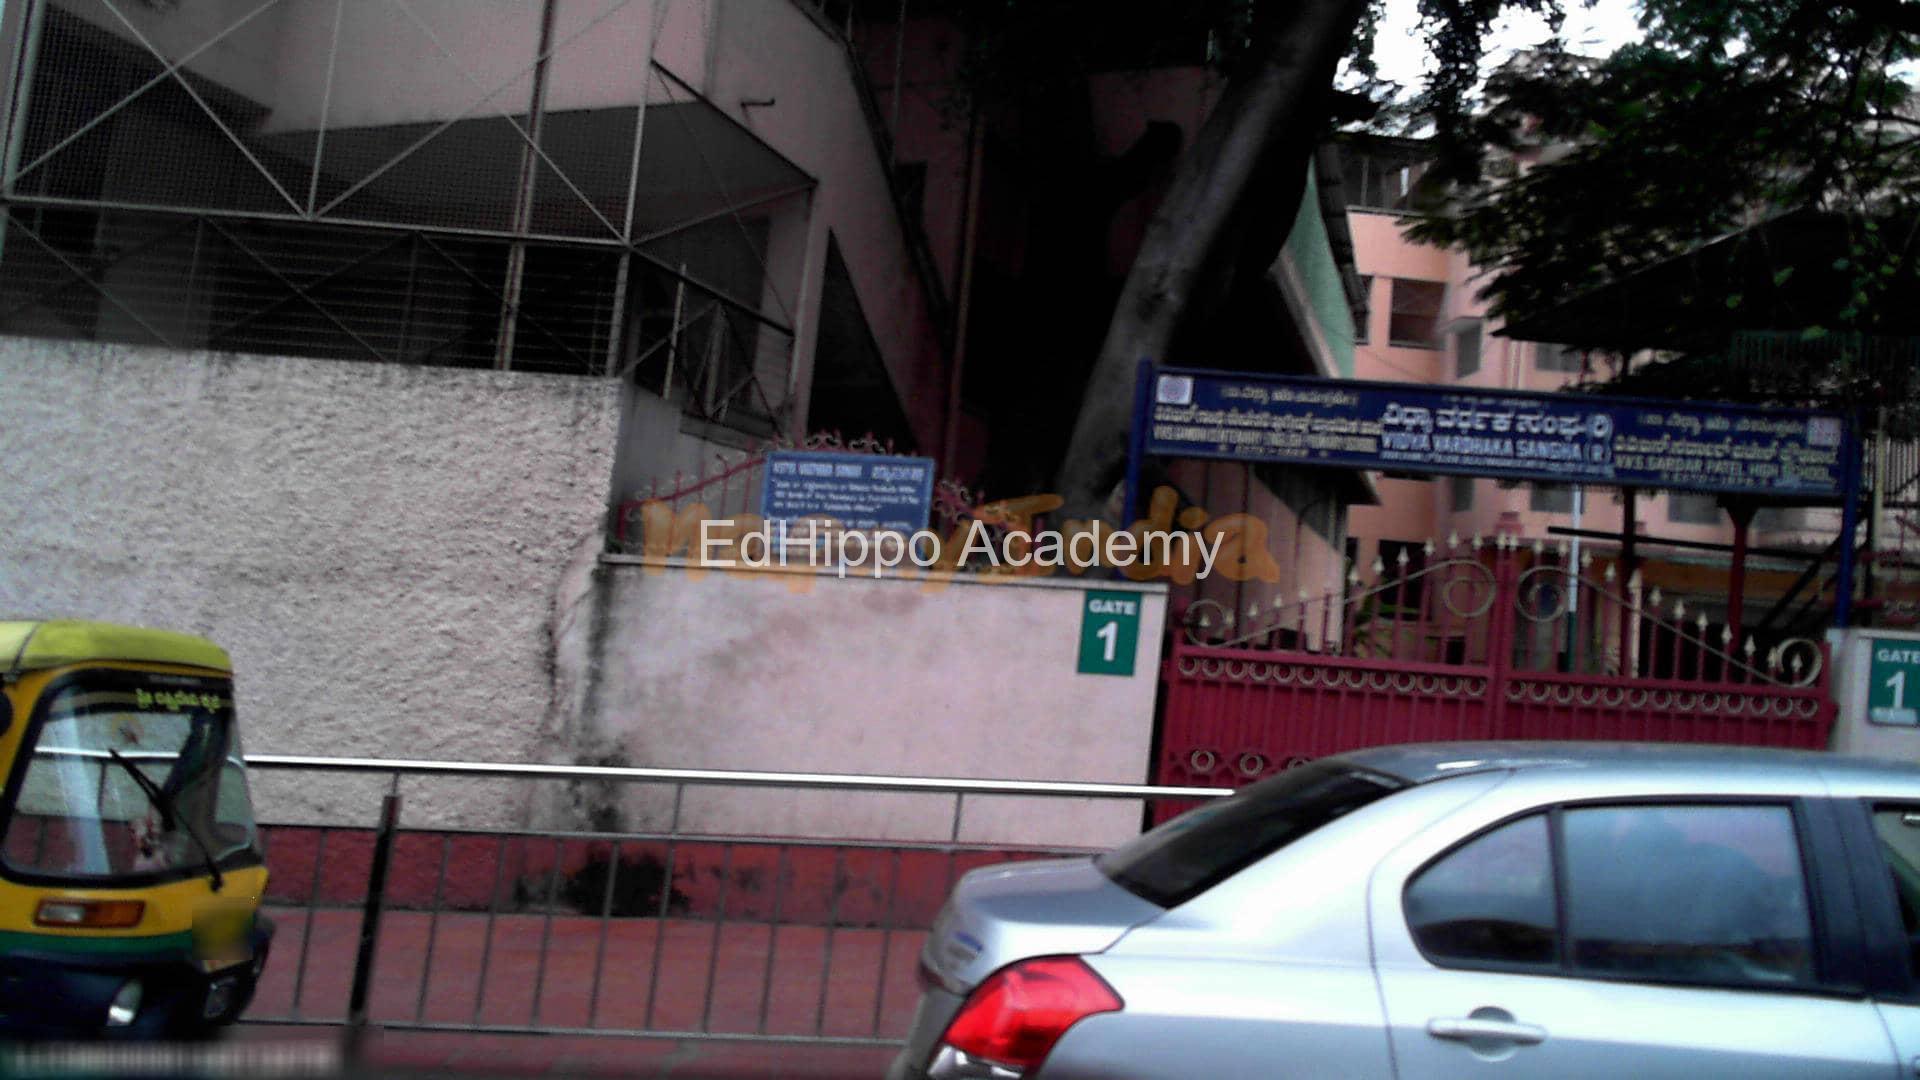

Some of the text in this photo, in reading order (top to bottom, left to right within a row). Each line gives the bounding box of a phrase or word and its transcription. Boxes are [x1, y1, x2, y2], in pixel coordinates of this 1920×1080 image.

[1089, 599, 1136, 616] GATE
[1096, 620, 1118, 661] 1
[1878, 648, 1920, 664] GATE
[1886, 671, 1906, 710] 1
